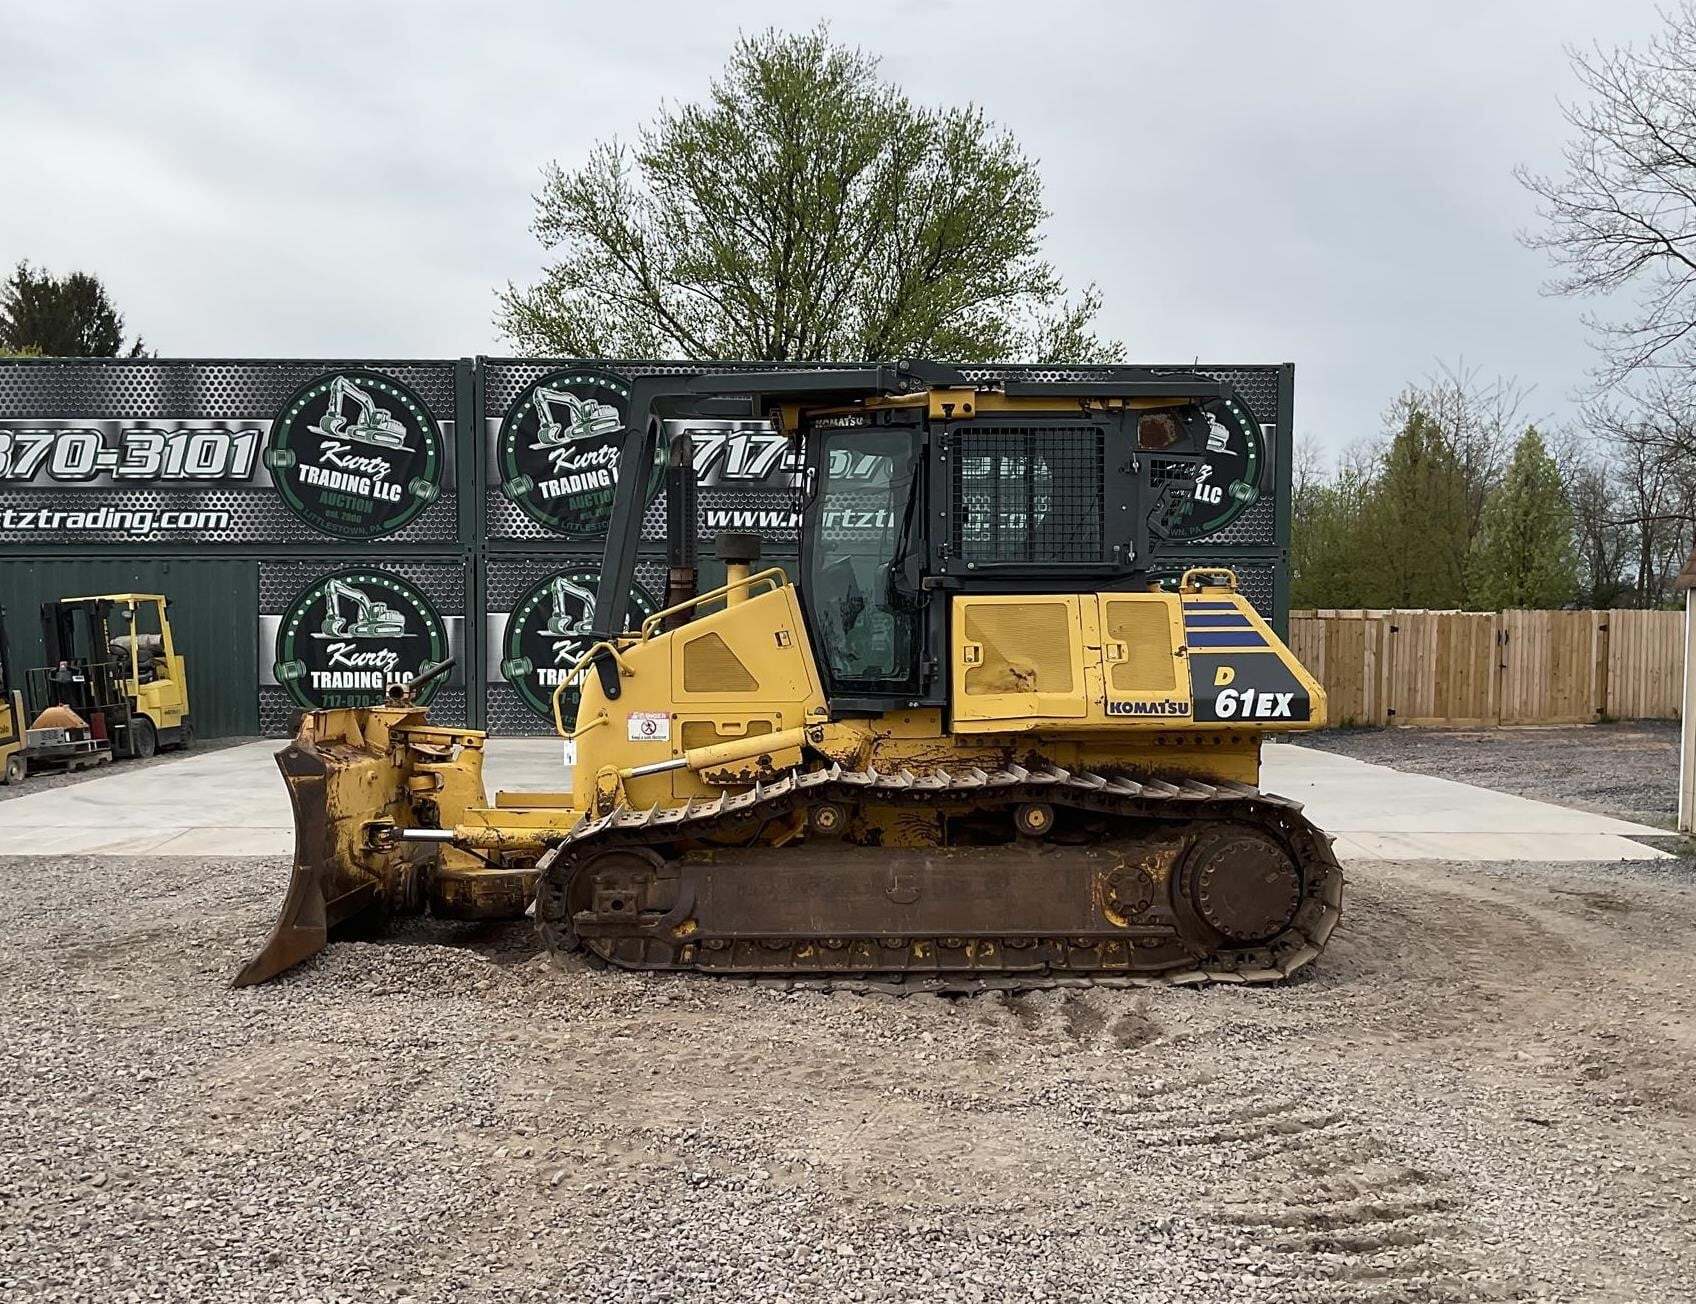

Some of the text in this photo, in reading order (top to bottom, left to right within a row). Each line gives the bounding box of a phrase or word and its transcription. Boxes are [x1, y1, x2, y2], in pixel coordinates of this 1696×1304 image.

[815, 415, 864, 429] KOMATSU
[0, 432, 256, 477] 70-3101
[320, 440, 392, 481] Kurtz
[548, 444, 621, 474] Kurtz
[299, 463, 402, 502] TRADING LLC
[538, 468, 611, 499] TRADING
[1194, 483, 1223, 504] LLC
[319, 490, 374, 514] AUCTION
[0, 507, 230, 534] tztrading.com
[326, 642, 399, 673] Kurtz
[311, 671, 383, 689] TRADING
[1214, 667, 1236, 686] D
[322, 694, 384, 708] 717-870-3
[1110, 699, 1189, 715] KOMATSU
[1215, 688, 1294, 718] 61EX
